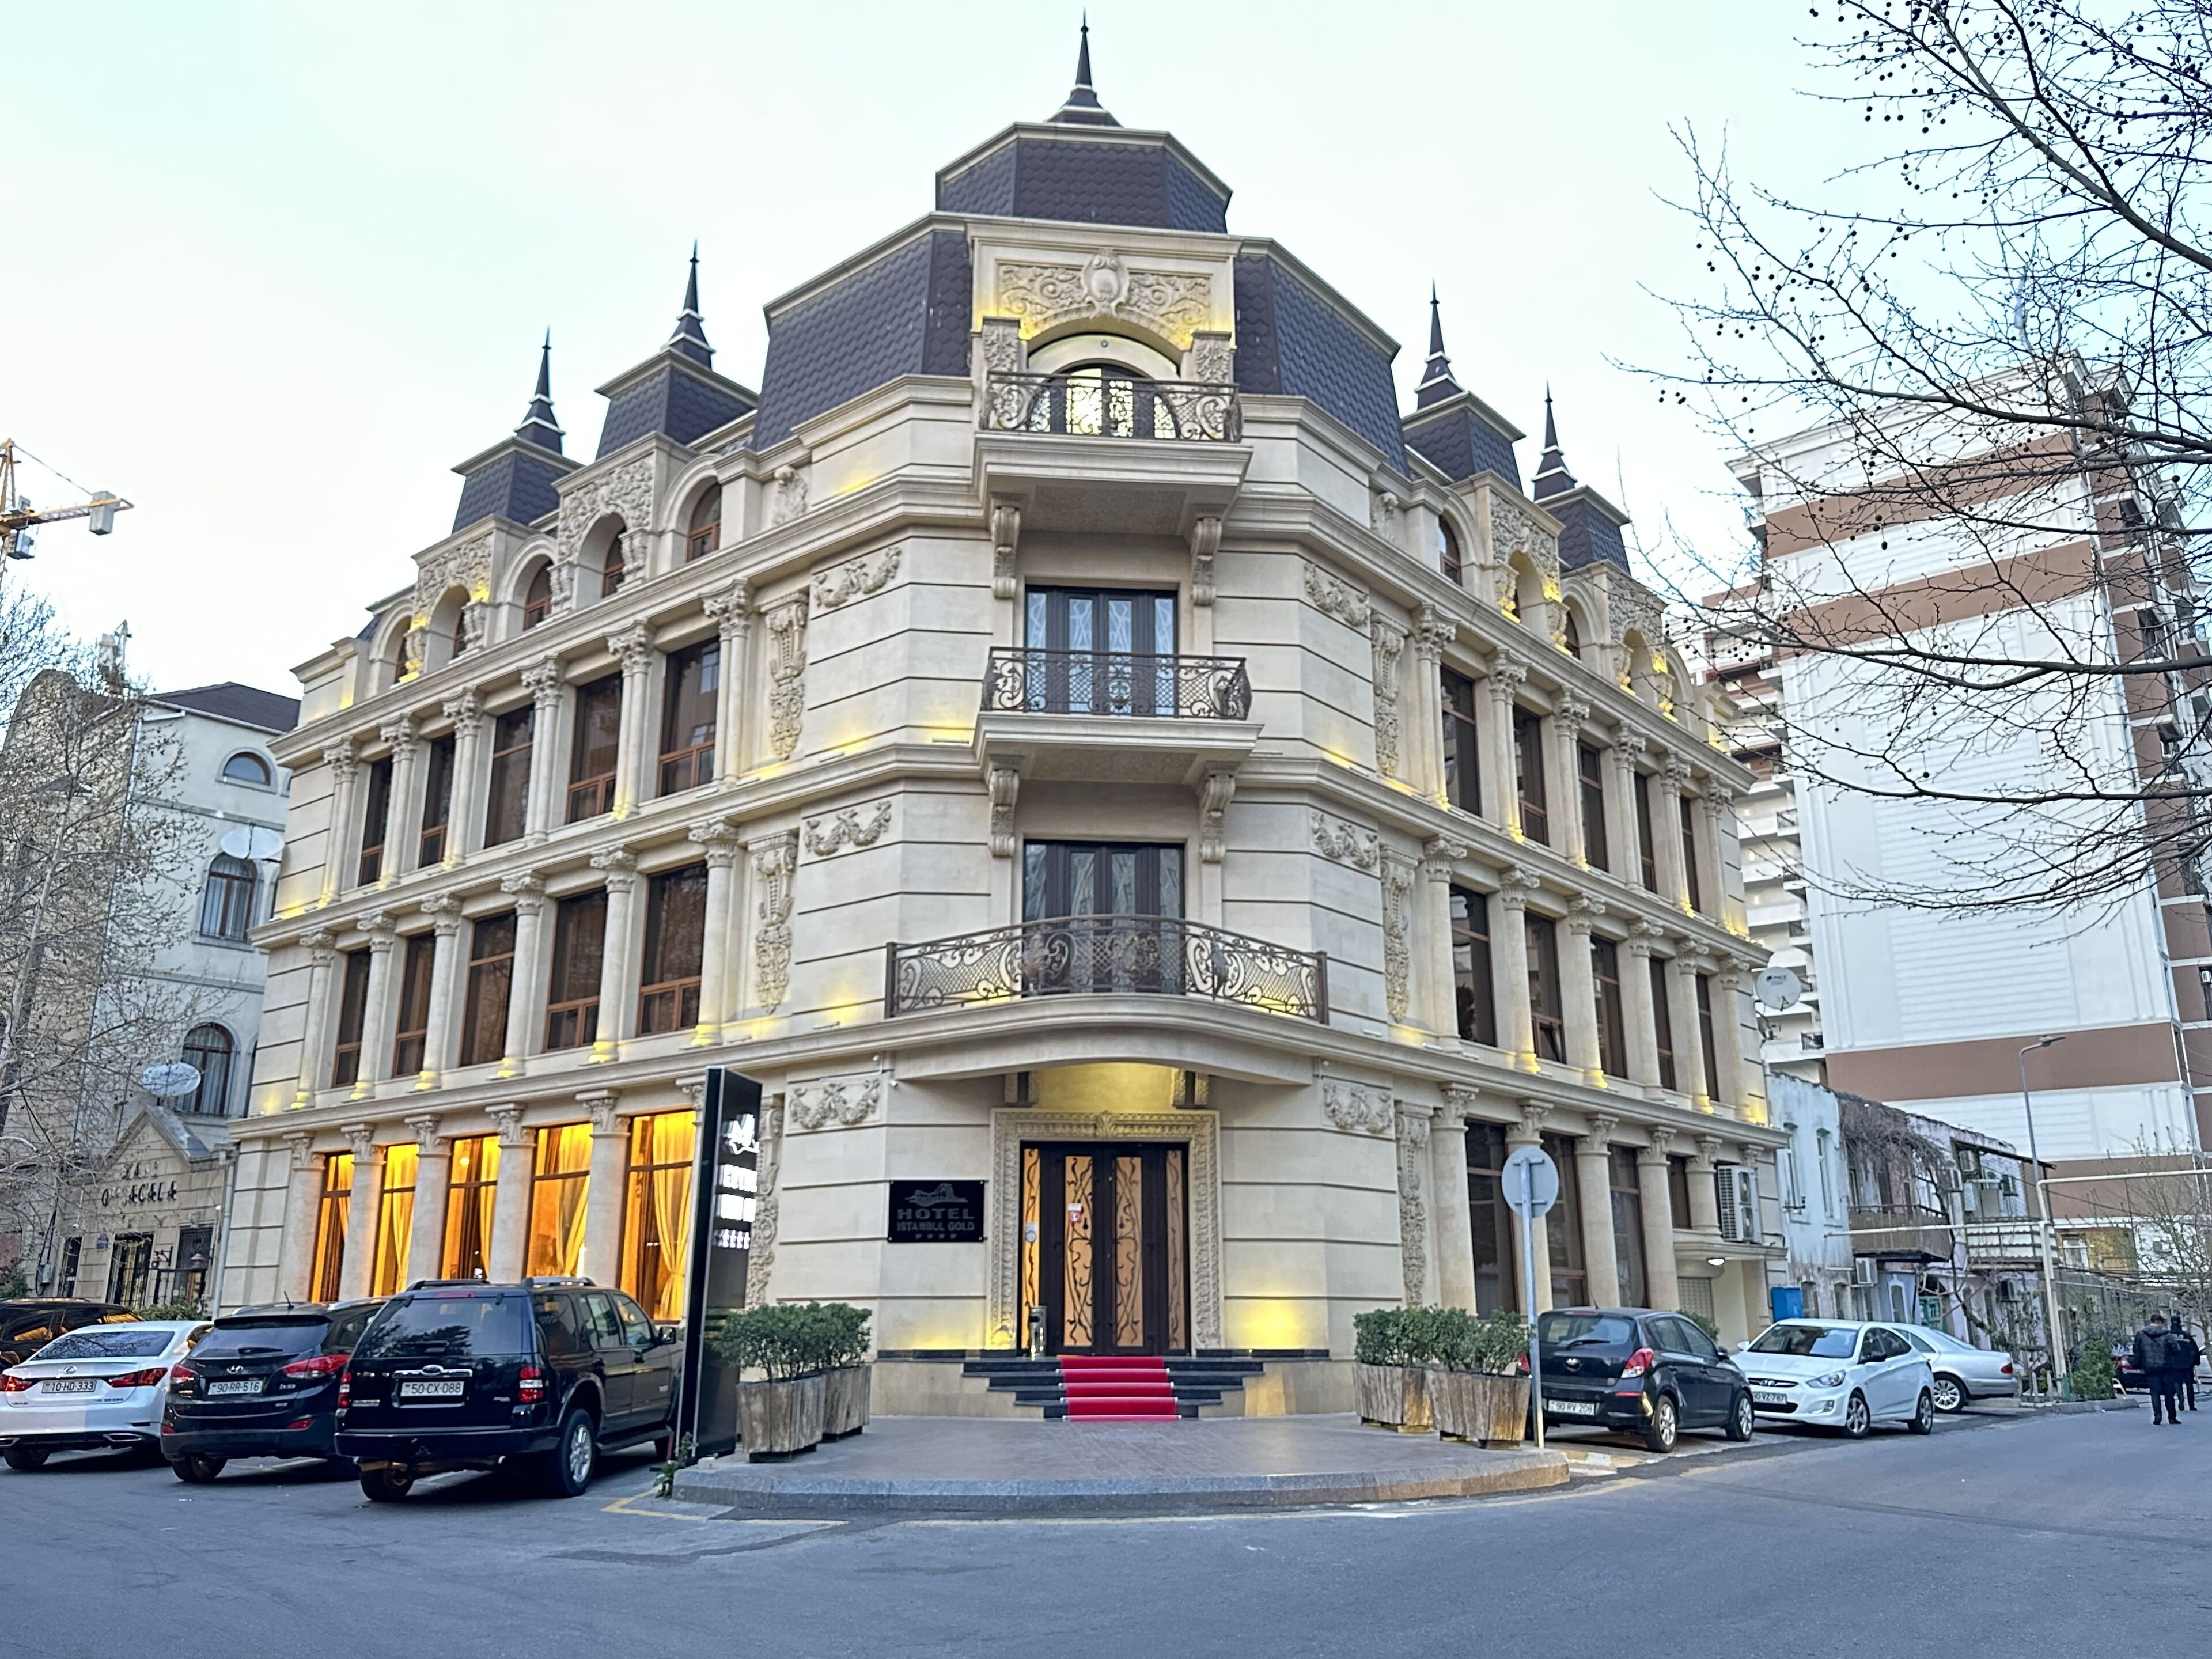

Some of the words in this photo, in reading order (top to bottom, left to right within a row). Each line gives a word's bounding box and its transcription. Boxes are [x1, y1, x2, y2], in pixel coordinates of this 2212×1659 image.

[897, 1208, 975, 1219] HOTEL
[948, 1222, 975, 1231] GOLD
[52, 1382, 93, 1391] 10-HD-333
[217, 1382, 260, 1393] 90-RR-516
[411, 1383, 461, 1394] 50-CX-088
